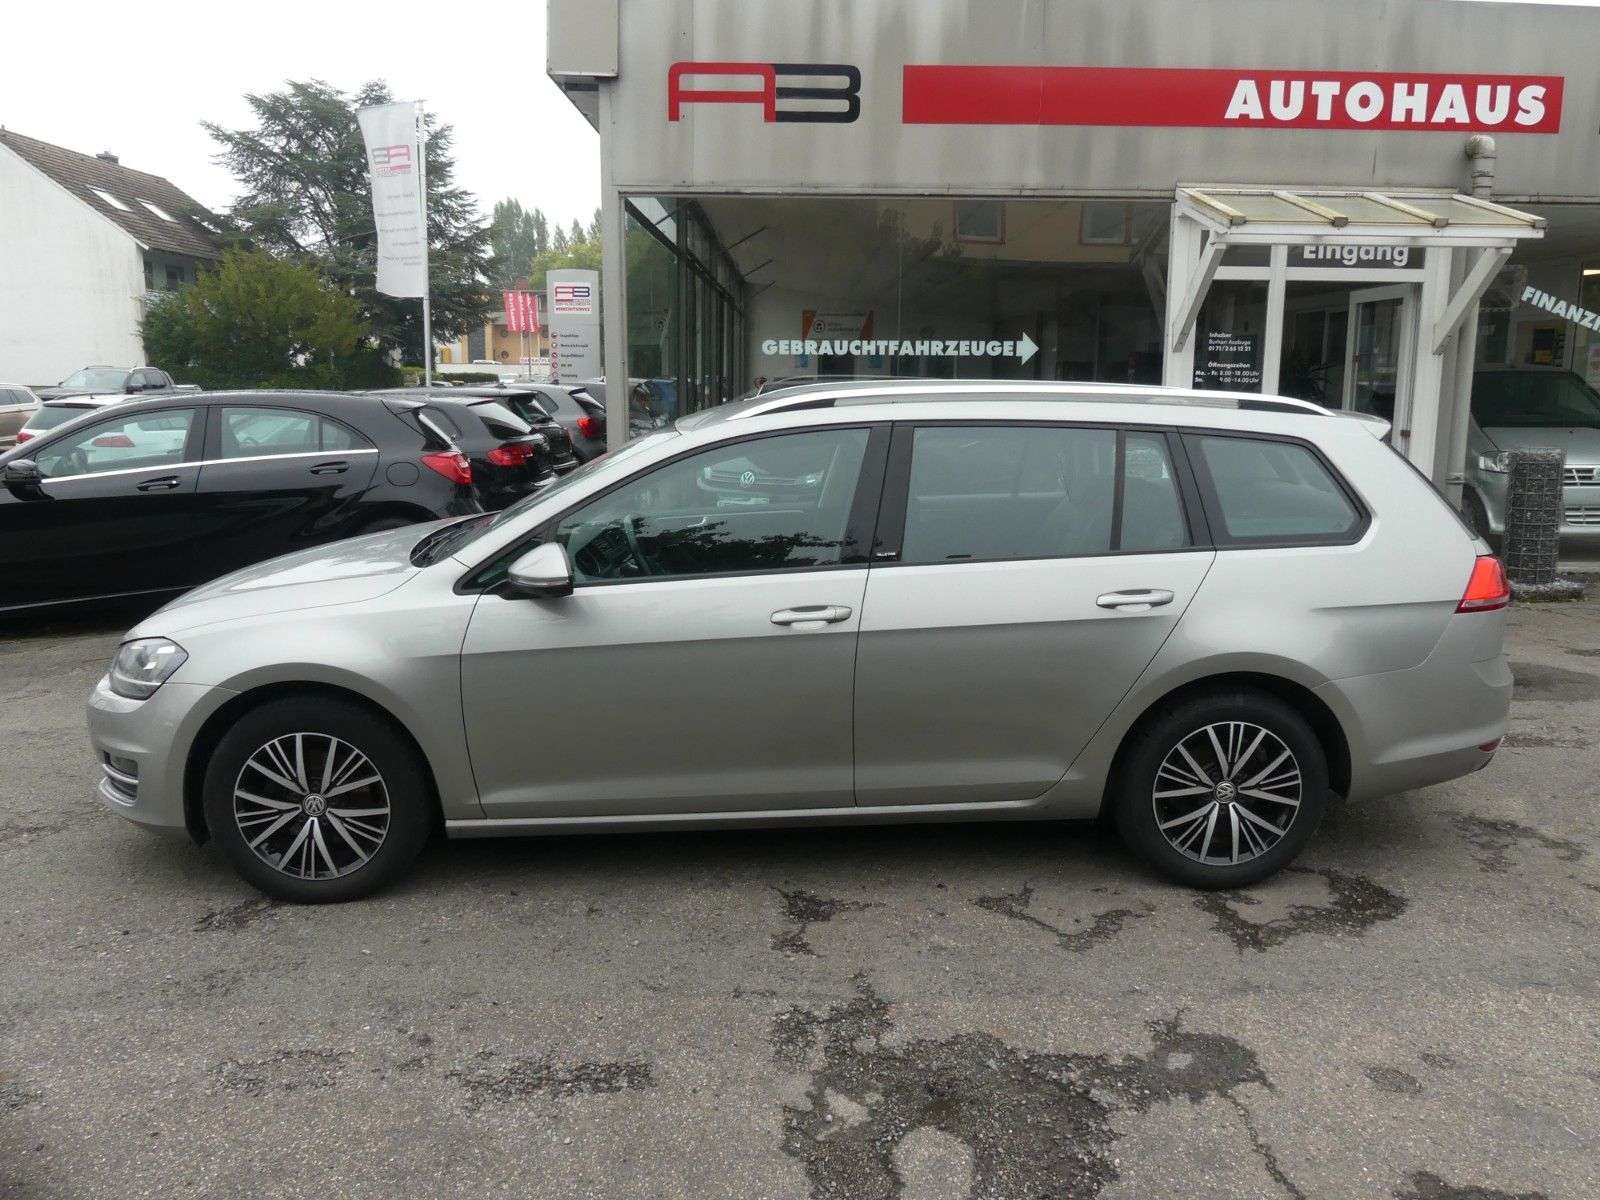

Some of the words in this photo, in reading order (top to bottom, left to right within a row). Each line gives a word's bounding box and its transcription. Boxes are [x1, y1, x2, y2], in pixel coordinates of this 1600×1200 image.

[668, 62, 861, 123] AB
[1224, 79, 1548, 127] AUTOHAUS
[1303, 245, 1409, 266] Eingang
[1521, 285, 1600, 333] FINANZI
[761, 339, 1012, 356] GEBRAUCHTFAHRZEUGE
